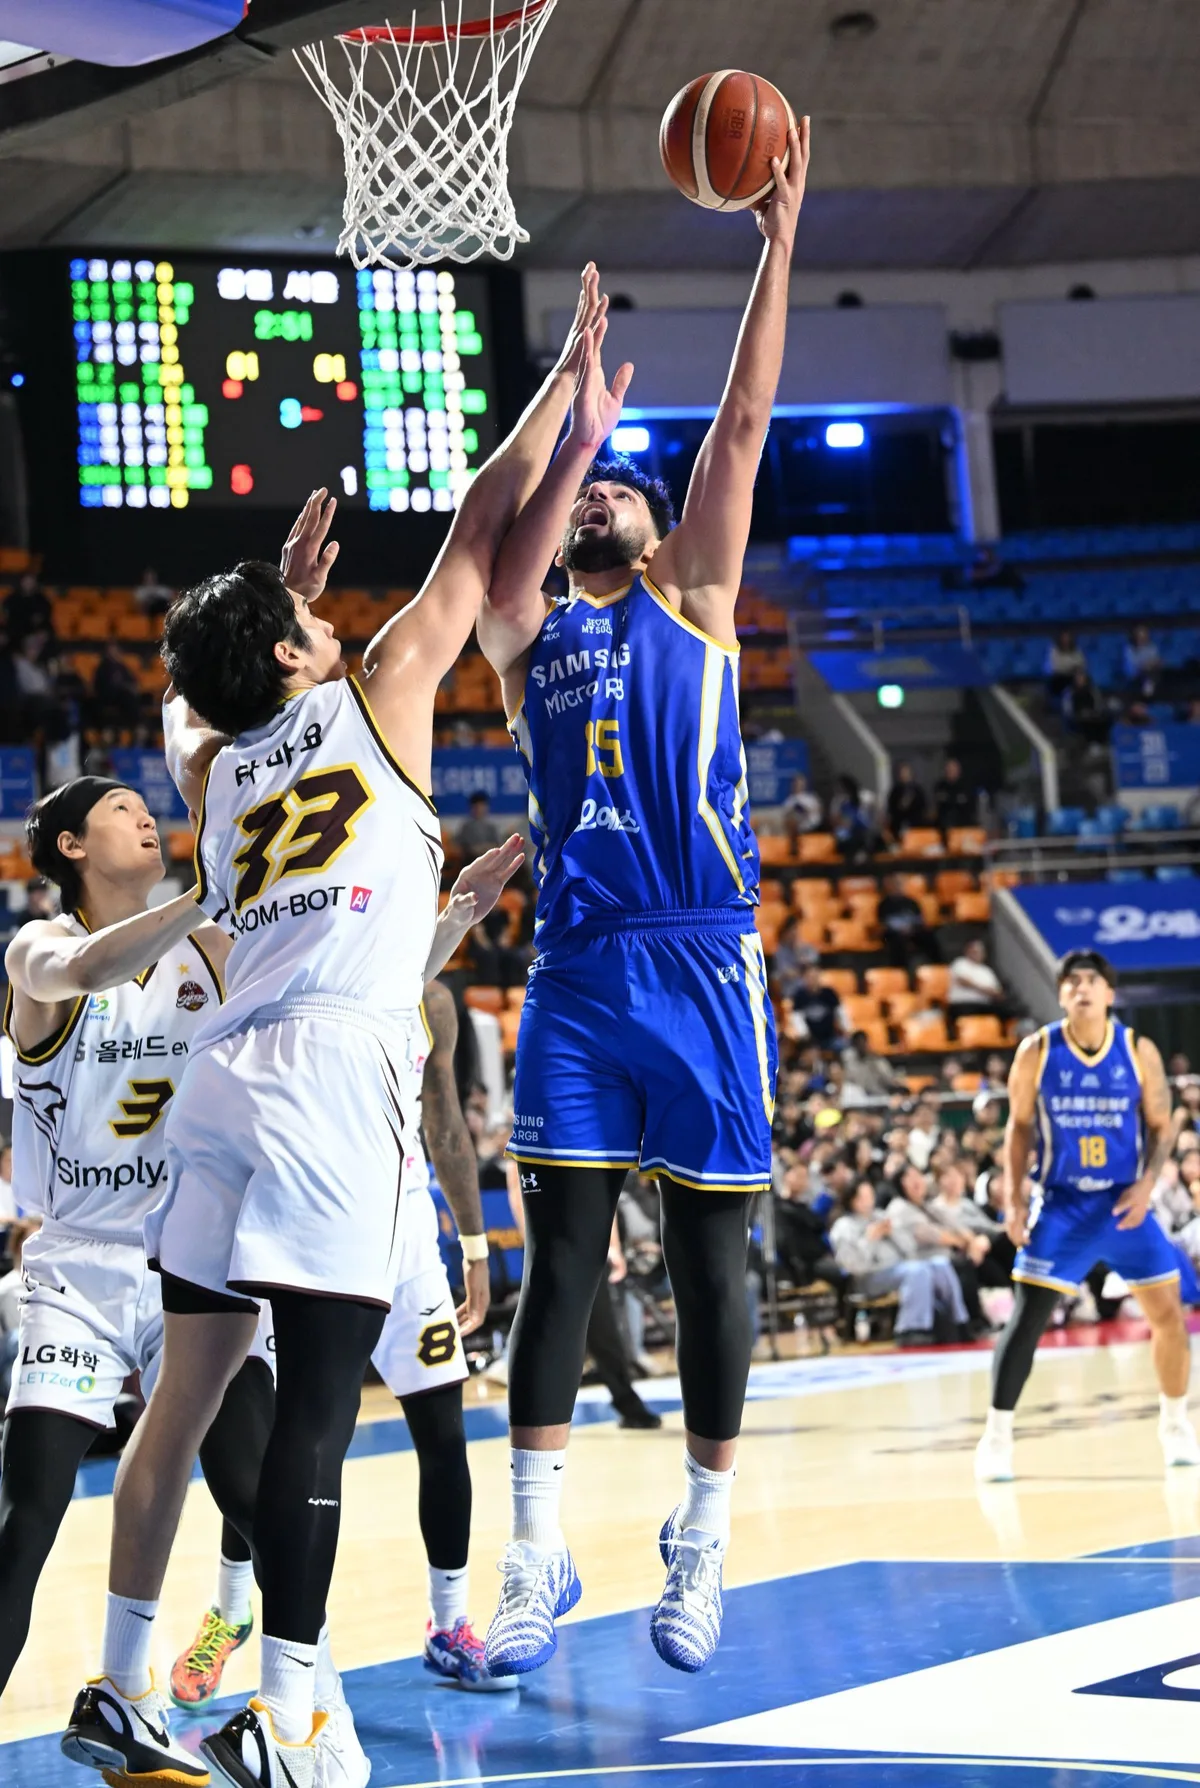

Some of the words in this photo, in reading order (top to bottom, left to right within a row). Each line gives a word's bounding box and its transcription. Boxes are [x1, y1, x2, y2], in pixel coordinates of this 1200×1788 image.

[585, 719, 624, 778] 15
[96, 1035, 168, 1063] 올레드
[108, 1077, 176, 1139] 3
[518, 1130, 539, 1142] RGB
[1079, 1136, 1107, 1168] 18
[57, 1156, 168, 1191] Simply.
[22, 1344, 56, 1366] LG
[59, 1346, 100, 1373] 화학
[416, 1320, 457, 1369] 8
